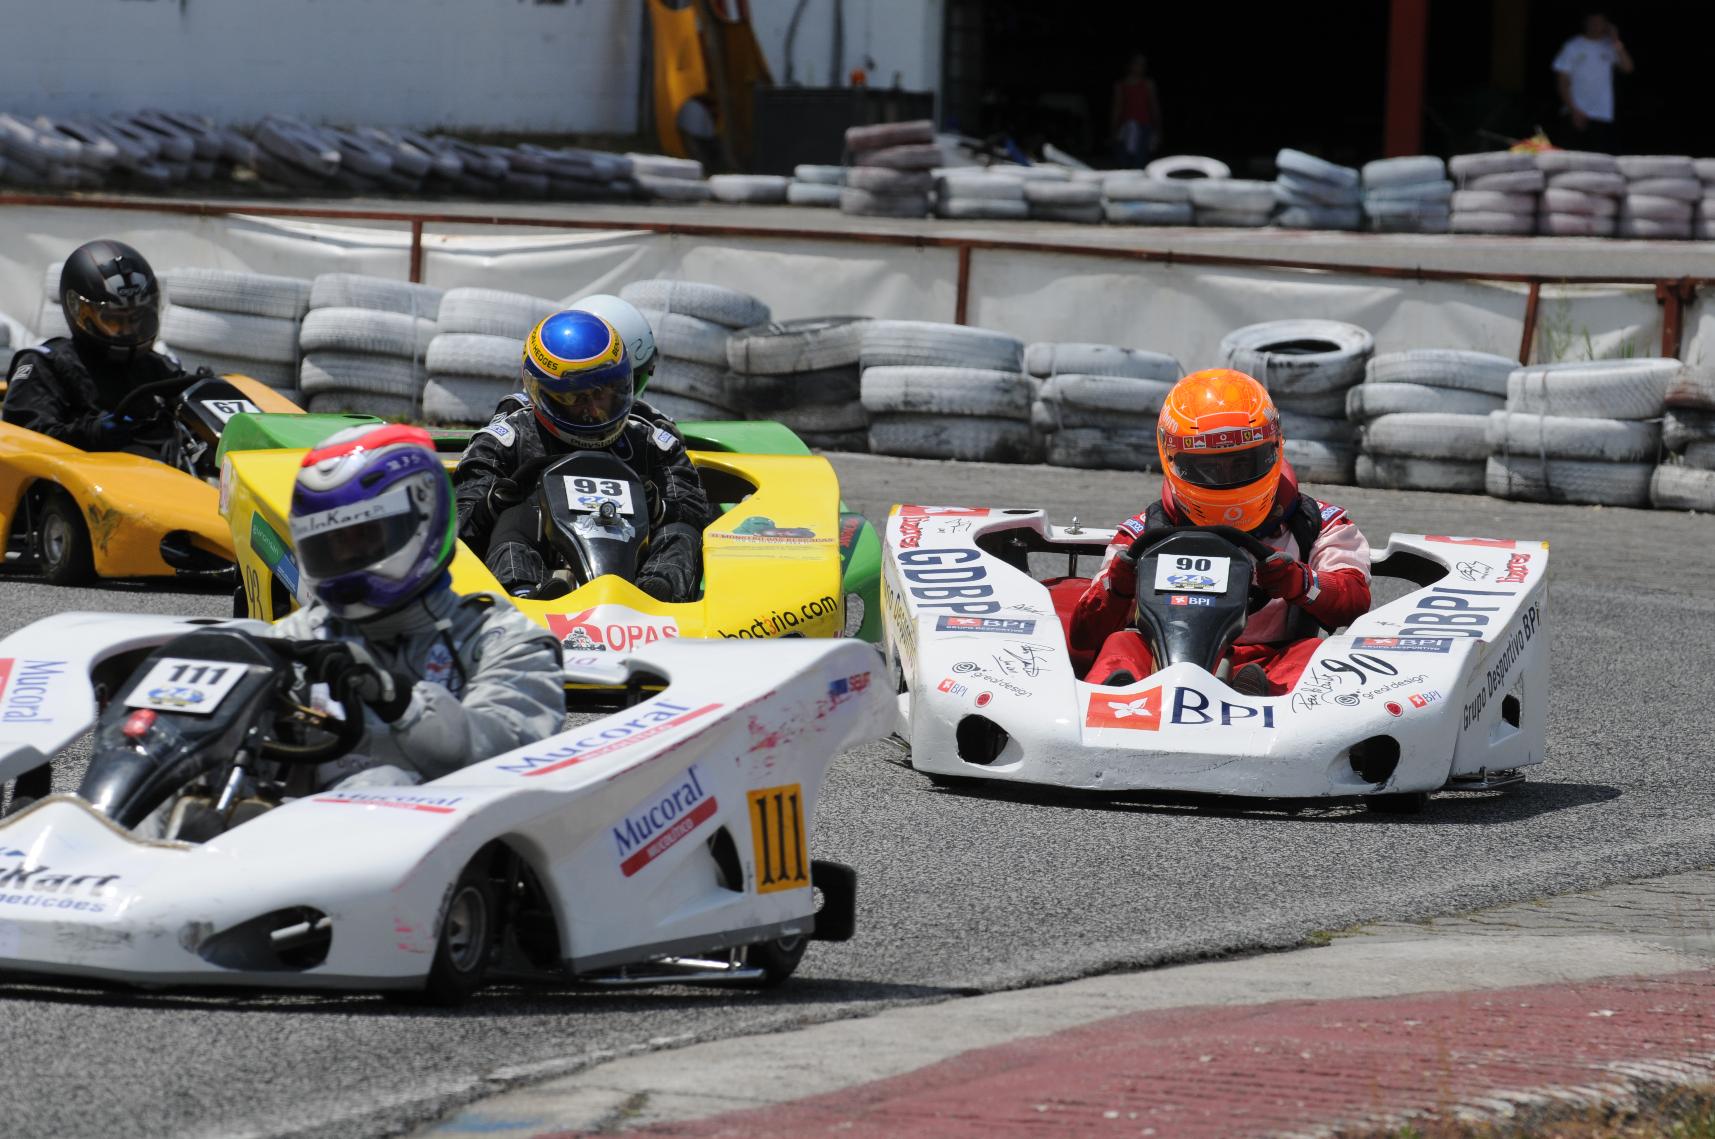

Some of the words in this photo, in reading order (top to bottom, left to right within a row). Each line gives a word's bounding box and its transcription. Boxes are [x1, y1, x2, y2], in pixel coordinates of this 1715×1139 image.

[533, 345, 559, 371] HEDGES
[213, 401, 247, 414] 67
[574, 478, 623, 497] 93
[1176, 557, 1211, 572] 90
[897, 548, 1002, 615] GDBP
[1188, 597, 1210, 606] BPI
[1398, 586, 1517, 638] DBPI
[983, 619, 1028, 629] BPI
[1399, 637, 1443, 647] BPI
[168, 664, 230, 685] 111
[1320, 653, 1399, 686] 90
[1463, 692, 1487, 731] Grupo
[1486, 628, 1526, 699] Desportivo
[2, 660, 68, 724] Mucoral
[950, 683, 968, 697] BPI
[1424, 689, 1443, 705] BPI
[1169, 686, 1276, 729] BPI
[496, 699, 692, 774] Mucoral
[612, 764, 706, 857] Mucoral
[755, 790, 807, 887] 111
[0, 861, 122, 897] Kart
